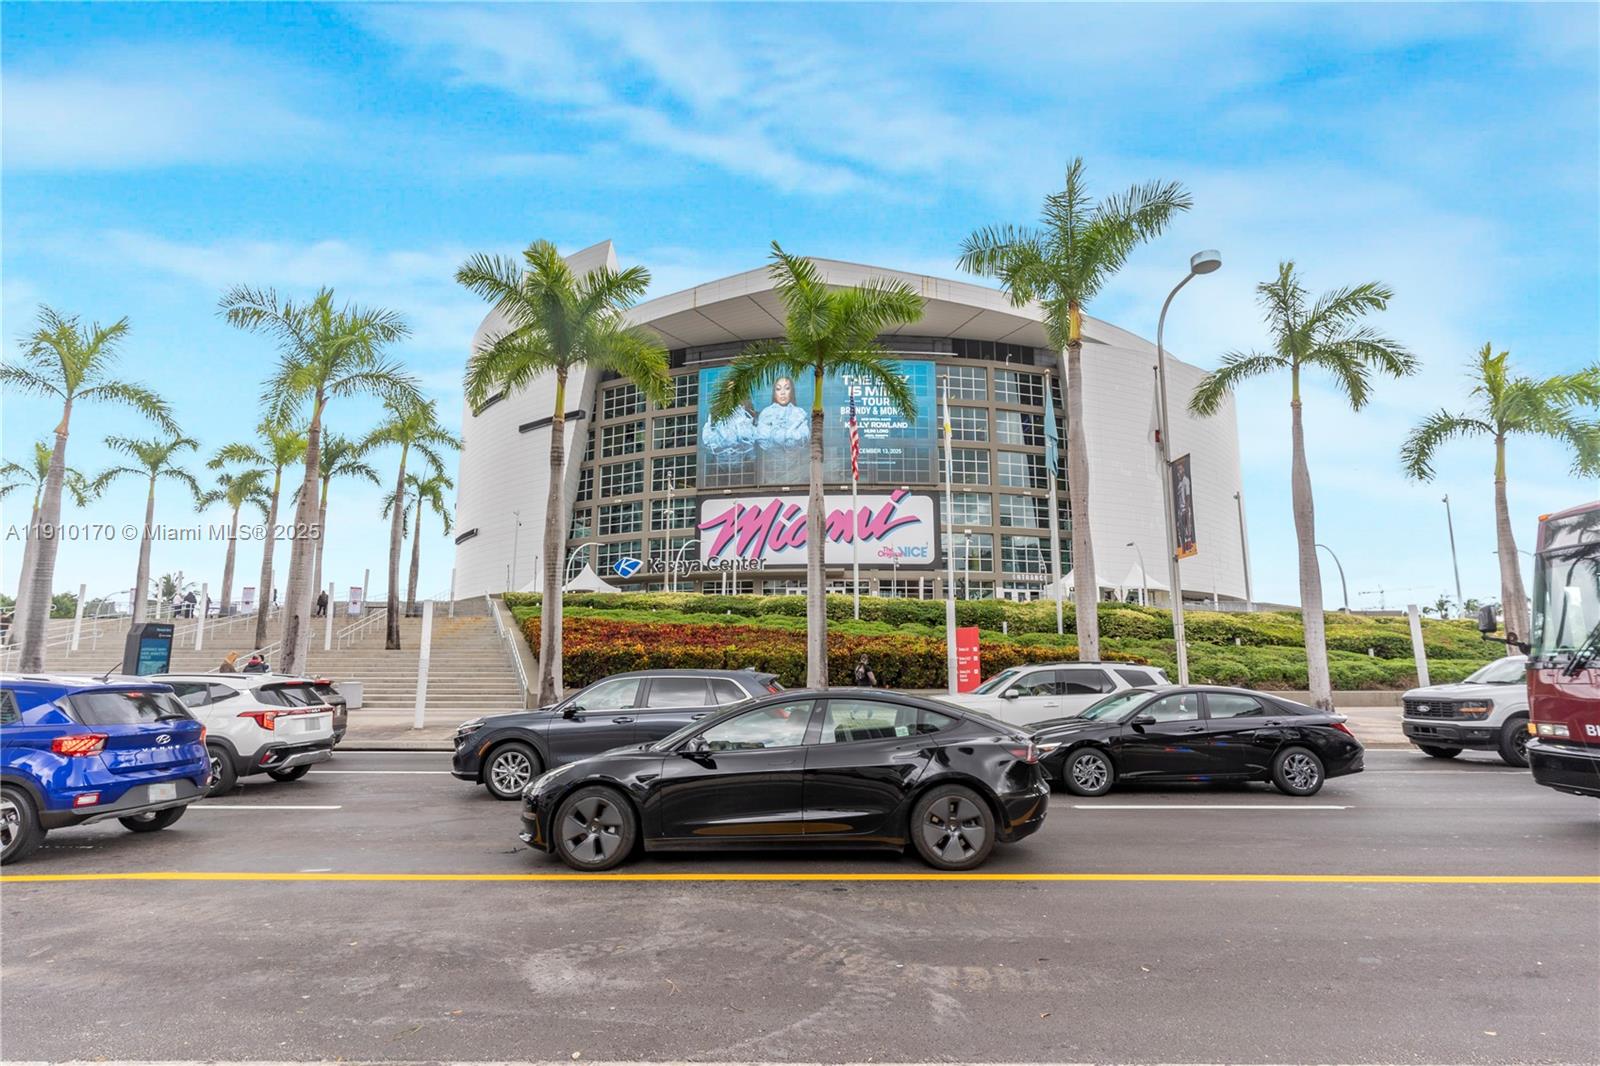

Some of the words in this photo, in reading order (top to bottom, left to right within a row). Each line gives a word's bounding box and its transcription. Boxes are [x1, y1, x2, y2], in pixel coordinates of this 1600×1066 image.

[848, 386, 862, 396] IS
[861, 397, 890, 406] TOUR
[840, 407, 871, 415] BRNDY
[872, 407, 879, 415] &
[697, 489, 921, 559] Miami
[897, 546, 928, 557] NICE
[648, 557, 701, 577] Kaseya
[706, 555, 766, 571] Center
